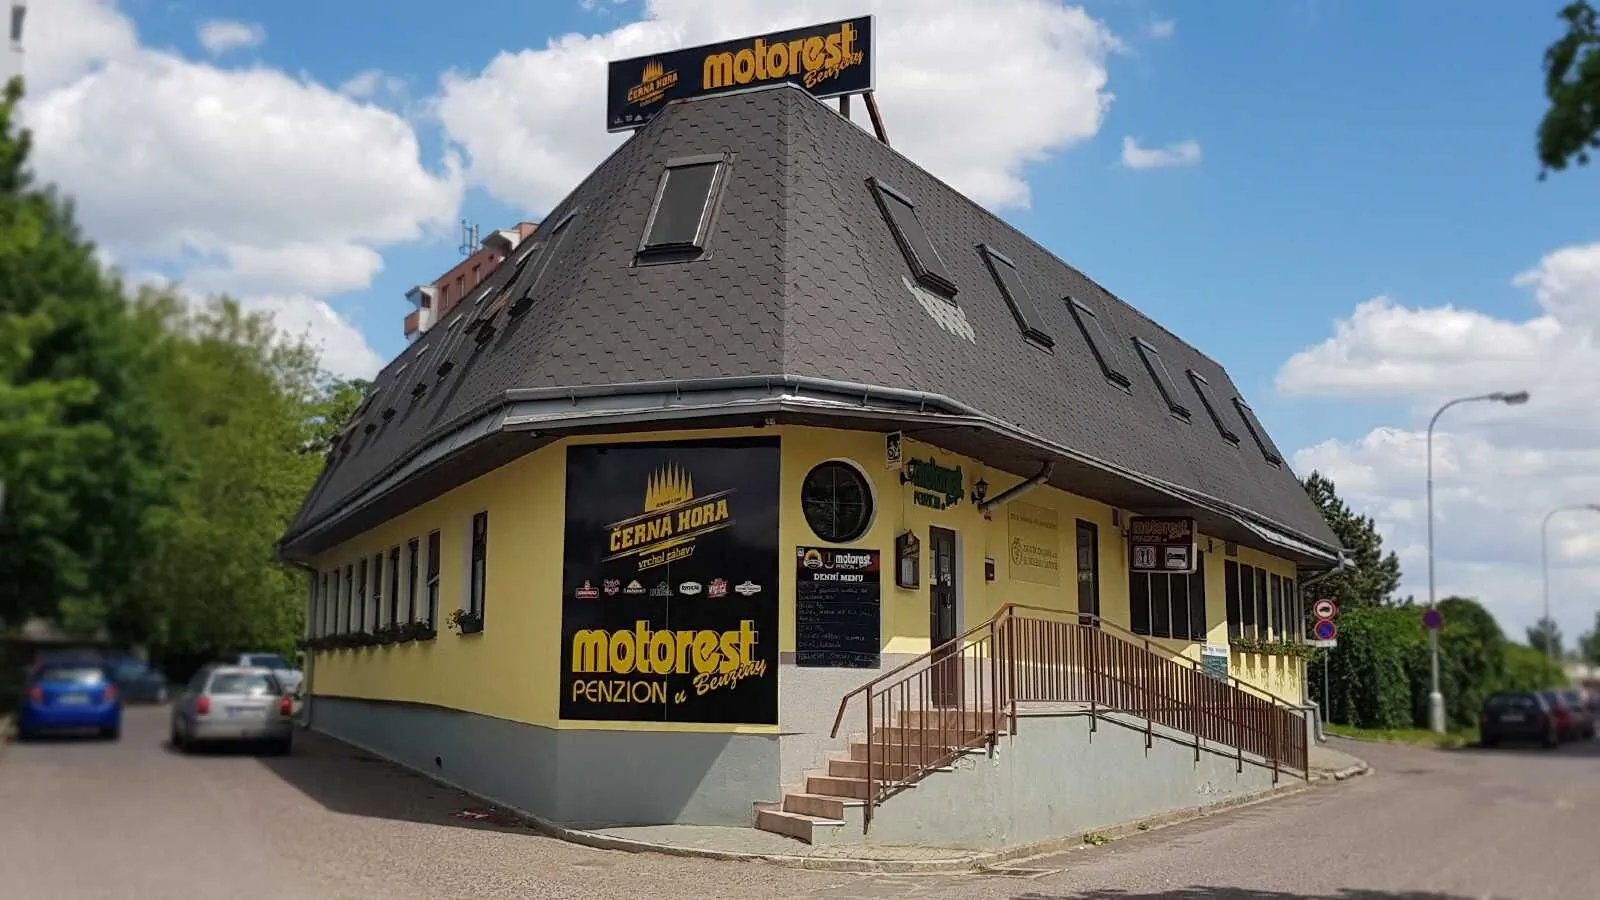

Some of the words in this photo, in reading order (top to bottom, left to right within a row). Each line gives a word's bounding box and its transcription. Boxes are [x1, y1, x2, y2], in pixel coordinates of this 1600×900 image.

[703, 23, 857, 90] motorest
[609, 512, 673, 552] ČERNÁ
[677, 498, 728, 533] HORA
[637, 550, 666, 569] vrchol
[813, 571, 840, 581] DENNÍ
[840, 574, 864, 582] MENU
[572, 619, 758, 675] motorest
[572, 679, 668, 704] PENZION
[674, 691, 688, 705] u
[692, 657, 768, 696] Benziny
